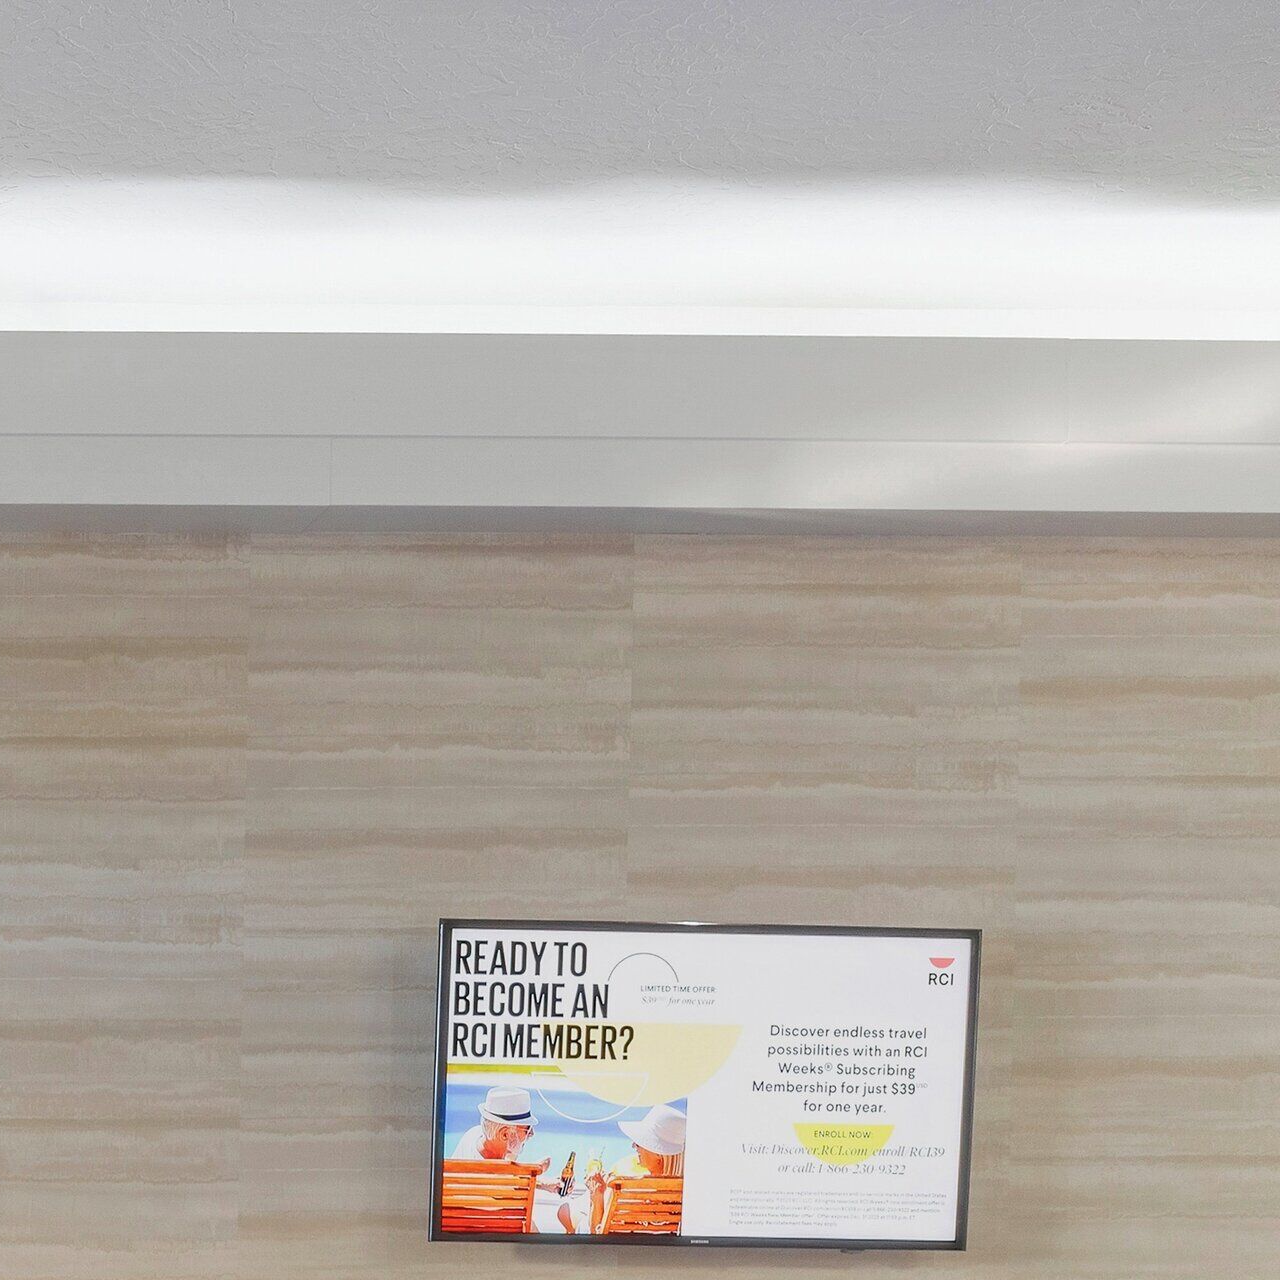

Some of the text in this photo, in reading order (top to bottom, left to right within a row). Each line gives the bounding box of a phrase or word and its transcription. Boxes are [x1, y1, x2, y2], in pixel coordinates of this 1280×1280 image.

[455, 940, 588, 977] READY TO
[928, 973, 954, 986] RCI
[640, 985, 671, 993] LIMITED
[673, 985, 690, 993] TIME
[453, 981, 609, 1018] BECOME AN
[770, 1025, 927, 1039] Discover endless travel
[451, 1022, 635, 1060] RCI MEMBER?
[767, 1044, 927, 1058] possibilities with an RCI
[836, 1063, 916, 1079] Subscribing
[752, 1081, 837, 1096] Membership
[841, 1081, 859, 1094] for
[862, 1082, 887, 1097] just
[803, 1099, 886, 1115] for one year.
[813, 1130, 847, 1139] ENROLL
[777, 1164, 790, 1173] or
